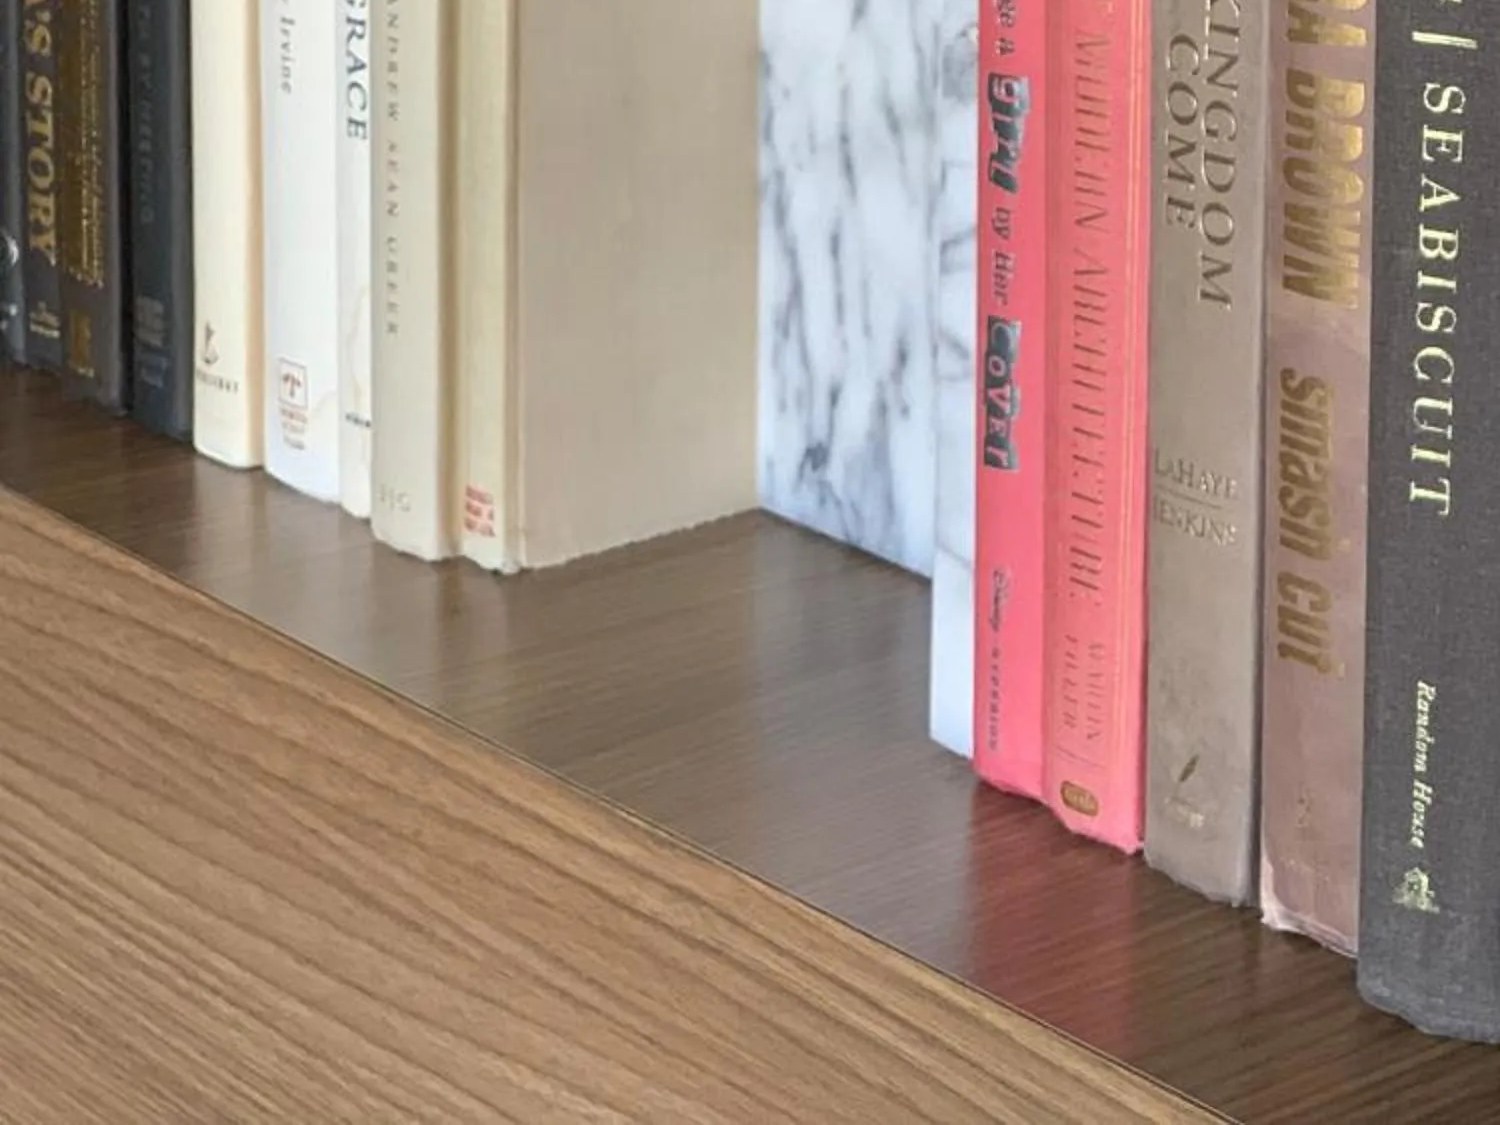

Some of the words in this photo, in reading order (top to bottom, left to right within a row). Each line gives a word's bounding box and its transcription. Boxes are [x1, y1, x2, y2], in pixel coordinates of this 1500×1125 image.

[279, 16, 295, 95] Irvine
[1073, 30, 1112, 234] MODERN
[1165, 33, 1199, 229] COME
[26, 72, 56, 265] STORY
[1281, 69, 1365, 309] BROWN
[1409, 81, 1467, 516] SEABISCUIT
[1068, 246, 1108, 606] ARCHITECTURE
[1152, 495, 1238, 547] JENKINS
[1410, 779, 1434, 849] House
[1413, 681, 1438, 775] Random
